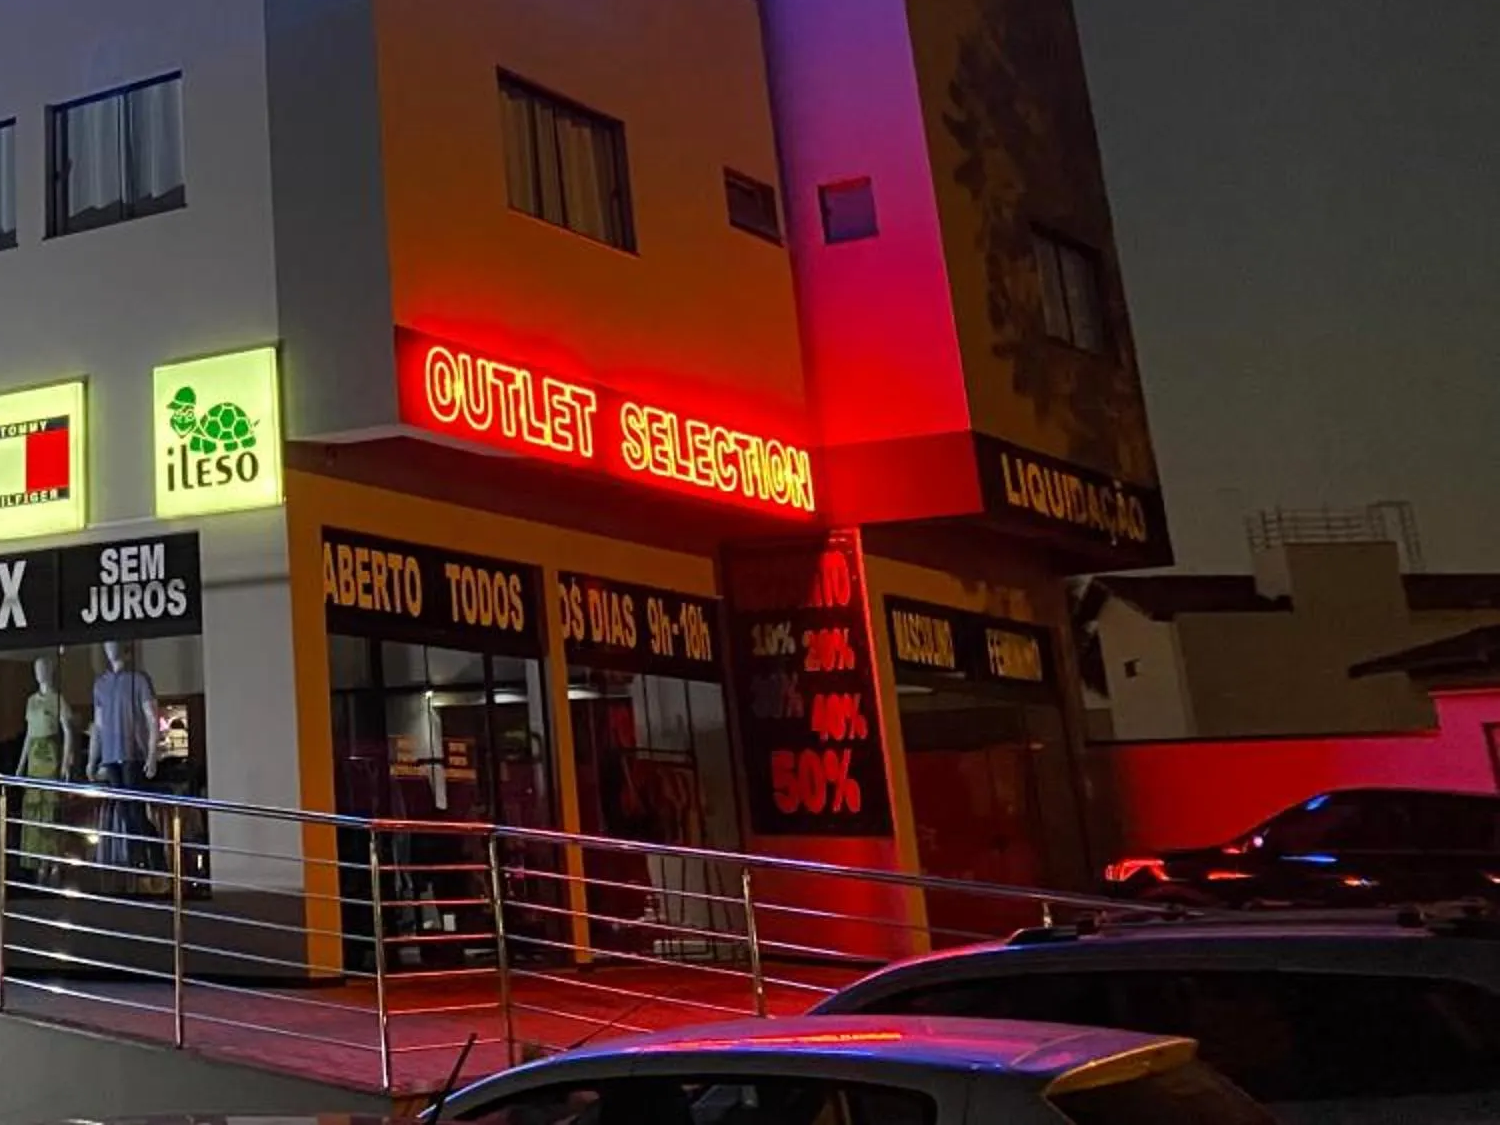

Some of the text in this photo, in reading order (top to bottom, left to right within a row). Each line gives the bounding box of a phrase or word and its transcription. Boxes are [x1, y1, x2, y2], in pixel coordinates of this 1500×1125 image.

[0, 420, 47, 438] TOMMY
[424, 346, 815, 512] OUTLET SELECTION
[100, 543, 165, 585] SEM
[323, 541, 525, 633] ABERTO TODOS
[81, 579, 188, 624] JUROS
[588, 587, 637, 650] DIAS
[771, 748, 862, 815] 50%
